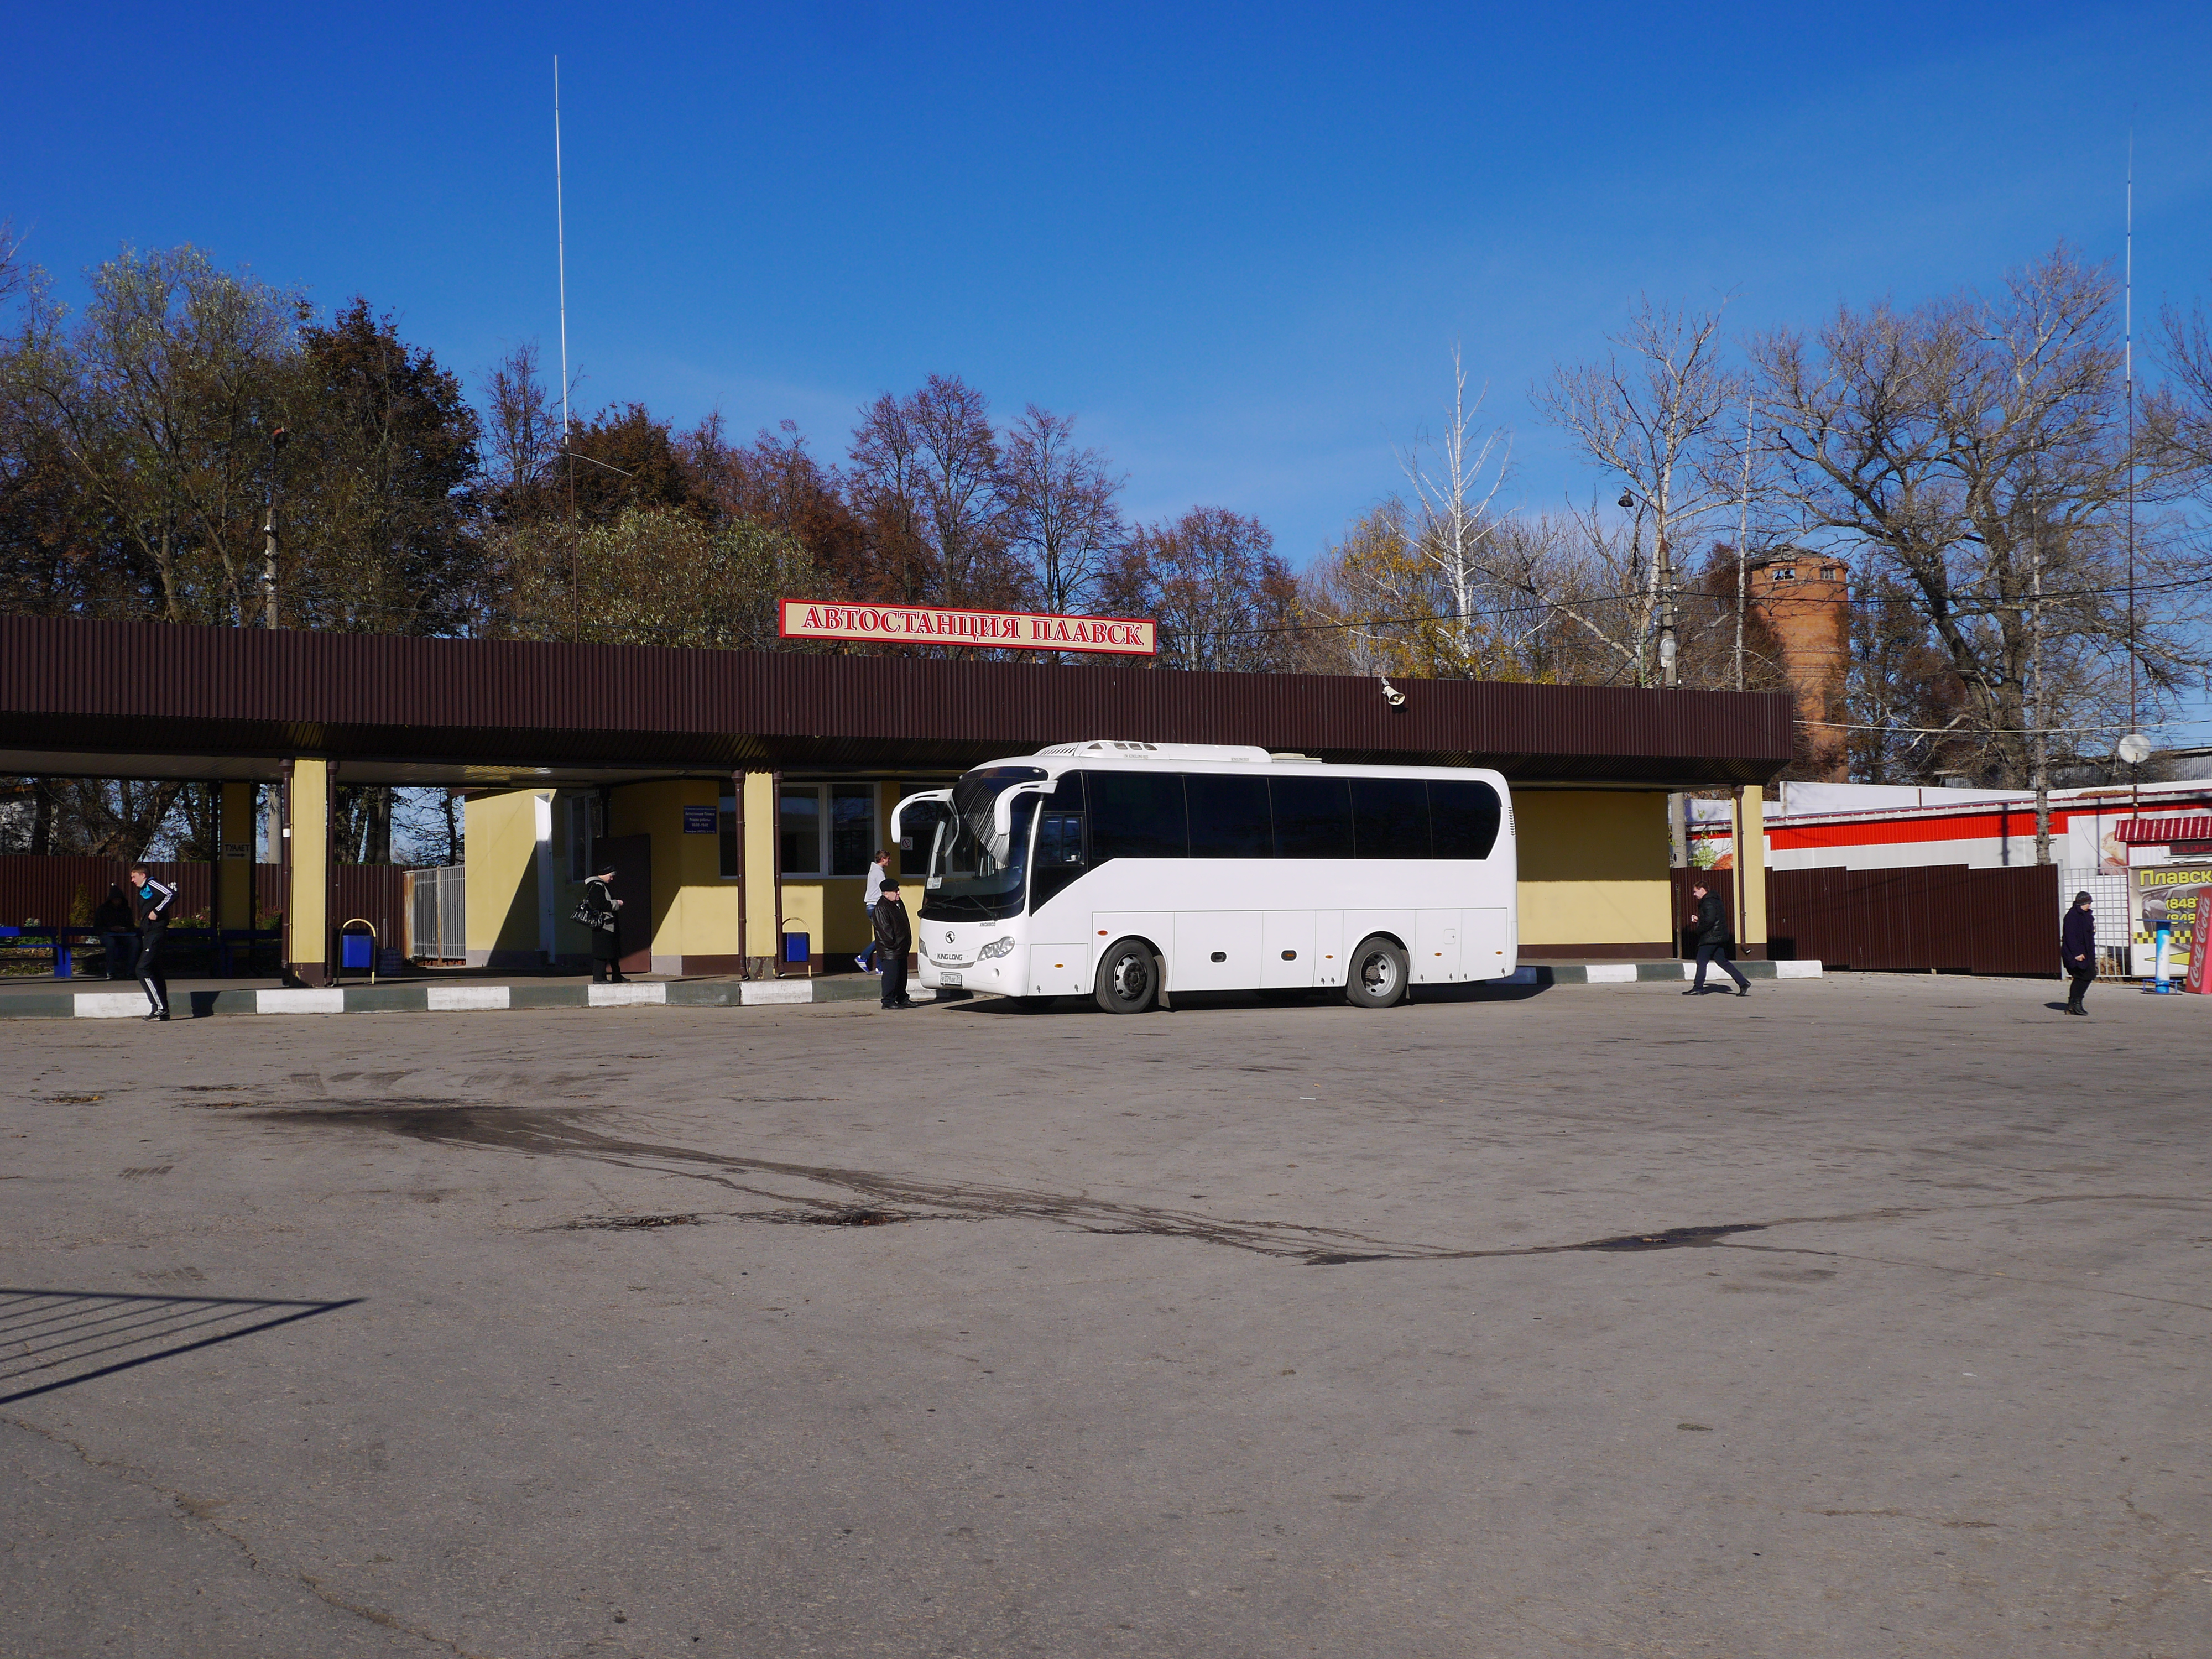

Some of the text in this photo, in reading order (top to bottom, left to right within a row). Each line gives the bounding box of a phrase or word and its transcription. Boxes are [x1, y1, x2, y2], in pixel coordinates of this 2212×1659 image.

[801, 606, 1144, 646] АВТОСТАНЦИЯ ПЛАВСК
[2140, 869, 2212, 886] Плавск
